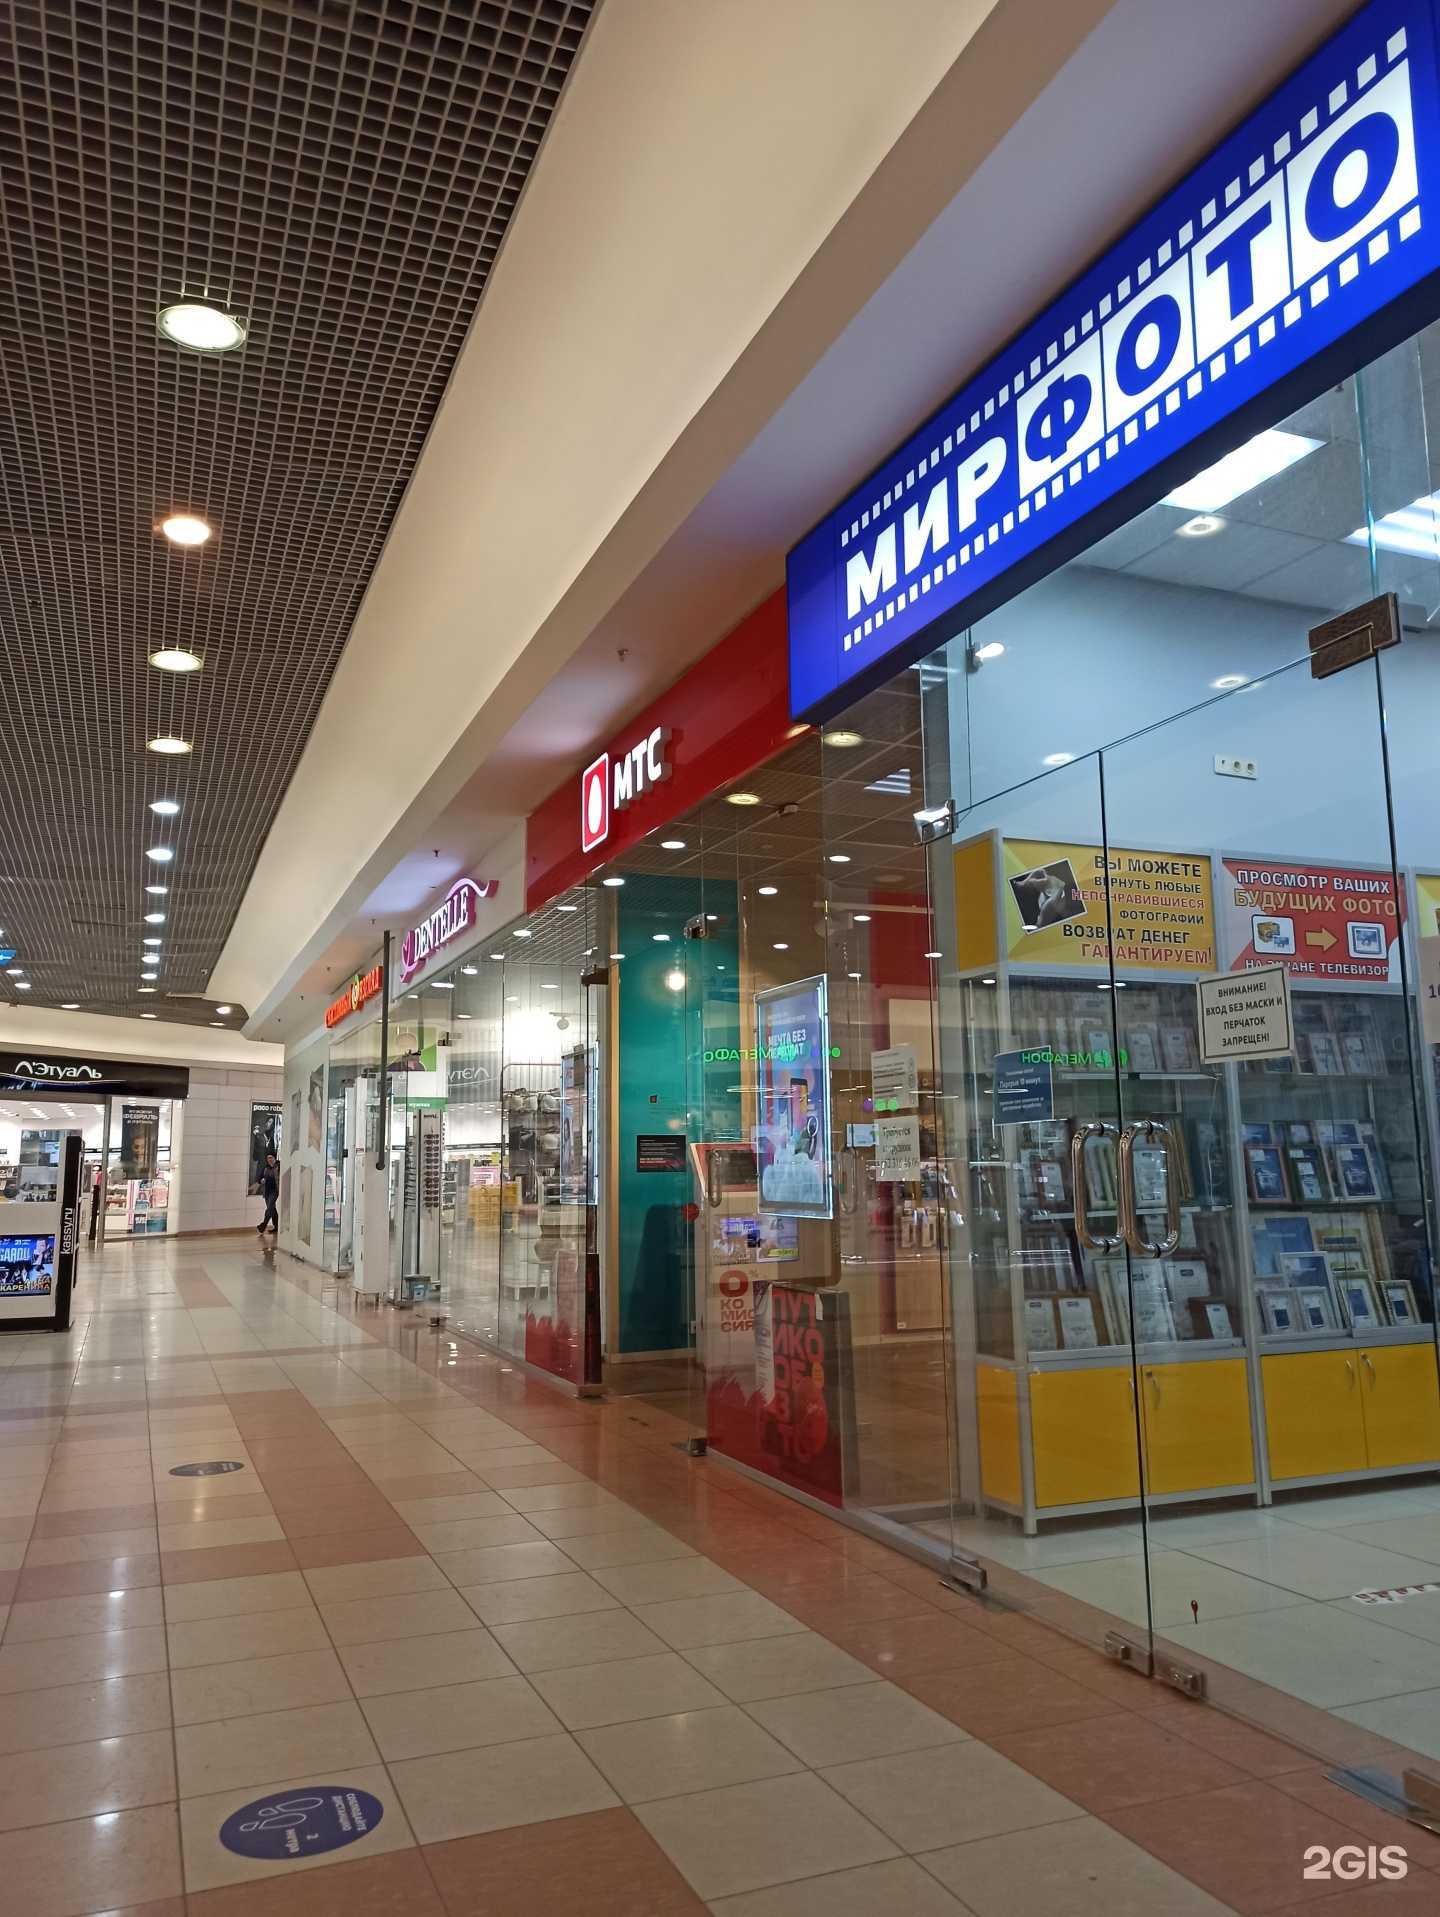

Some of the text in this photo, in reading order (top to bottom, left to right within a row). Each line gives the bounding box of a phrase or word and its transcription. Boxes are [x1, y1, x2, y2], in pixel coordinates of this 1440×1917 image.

[613, 726, 662, 809] МТС
[1094, 856, 1201, 878] ВЫ МОЖЕТЕ
[1094, 876, 1201, 894] ВРНУТЬ ЛЮБЫЕ
[1236, 870, 1390, 895] ПРОСМОТР ВАШИХ
[1234, 888, 1397, 916] БУДУЩИХ ФОТО
[413, 886, 469, 962] DENTELLE
[1119, 910, 1204, 925] ФОТОГРАФИИ
[1063, 924, 1190, 945] ВОЗВАТ ДЕНЕГ
[1218, 982, 1267, 998] ВНИМАНИЕ!
[1205, 997, 1283, 1017] ВХОД БЕЗ МАСКИ И
[1223, 1016, 1266, 1030] ПЕРЧАТОК
[1222, 1034, 1270, 1048] ЗАПРЕЩЕН!
[60, 1207, 73, 1255] kassy.ru
[720, 1299, 744, 1310] КО
